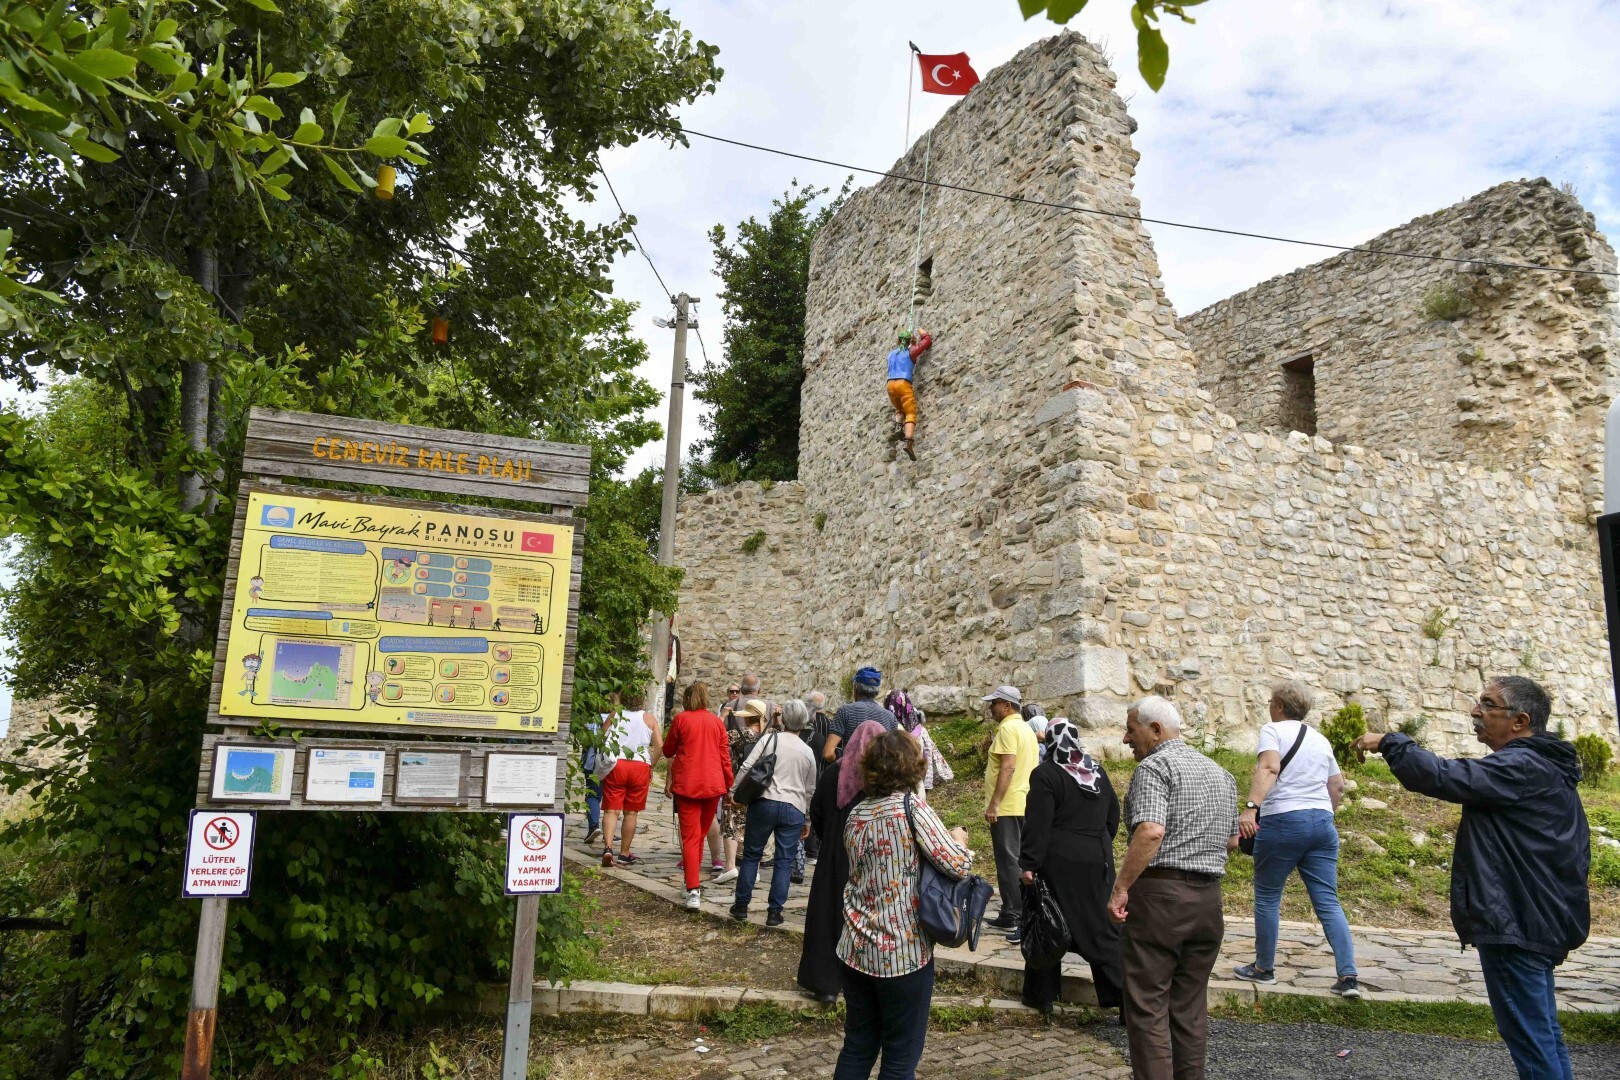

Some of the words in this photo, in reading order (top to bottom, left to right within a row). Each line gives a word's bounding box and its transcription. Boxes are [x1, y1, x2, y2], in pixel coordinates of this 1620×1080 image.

[417, 448, 470, 476] KALE
[477, 455, 532, 482] PLAJI
[298, 511, 353, 530] Mavi
[350, 516, 420, 541] Bayrak
[425, 522, 515, 543] PANOSU
[424, 534, 449, 544] Blue
[455, 537, 478, 548] Flag
[484, 540, 514, 549] Panel
[202, 854, 236, 864] LÜTFEN
[523, 854, 547, 862] KAMP
[190, 867, 228, 876] YERLERE
[229, 866, 246, 877] ÇÖP
[517, 866, 552, 874] YAPMAK
[192, 879, 241, 887] ATMAYINIZ!
[512, 878, 555, 887] YASAKTIR!
